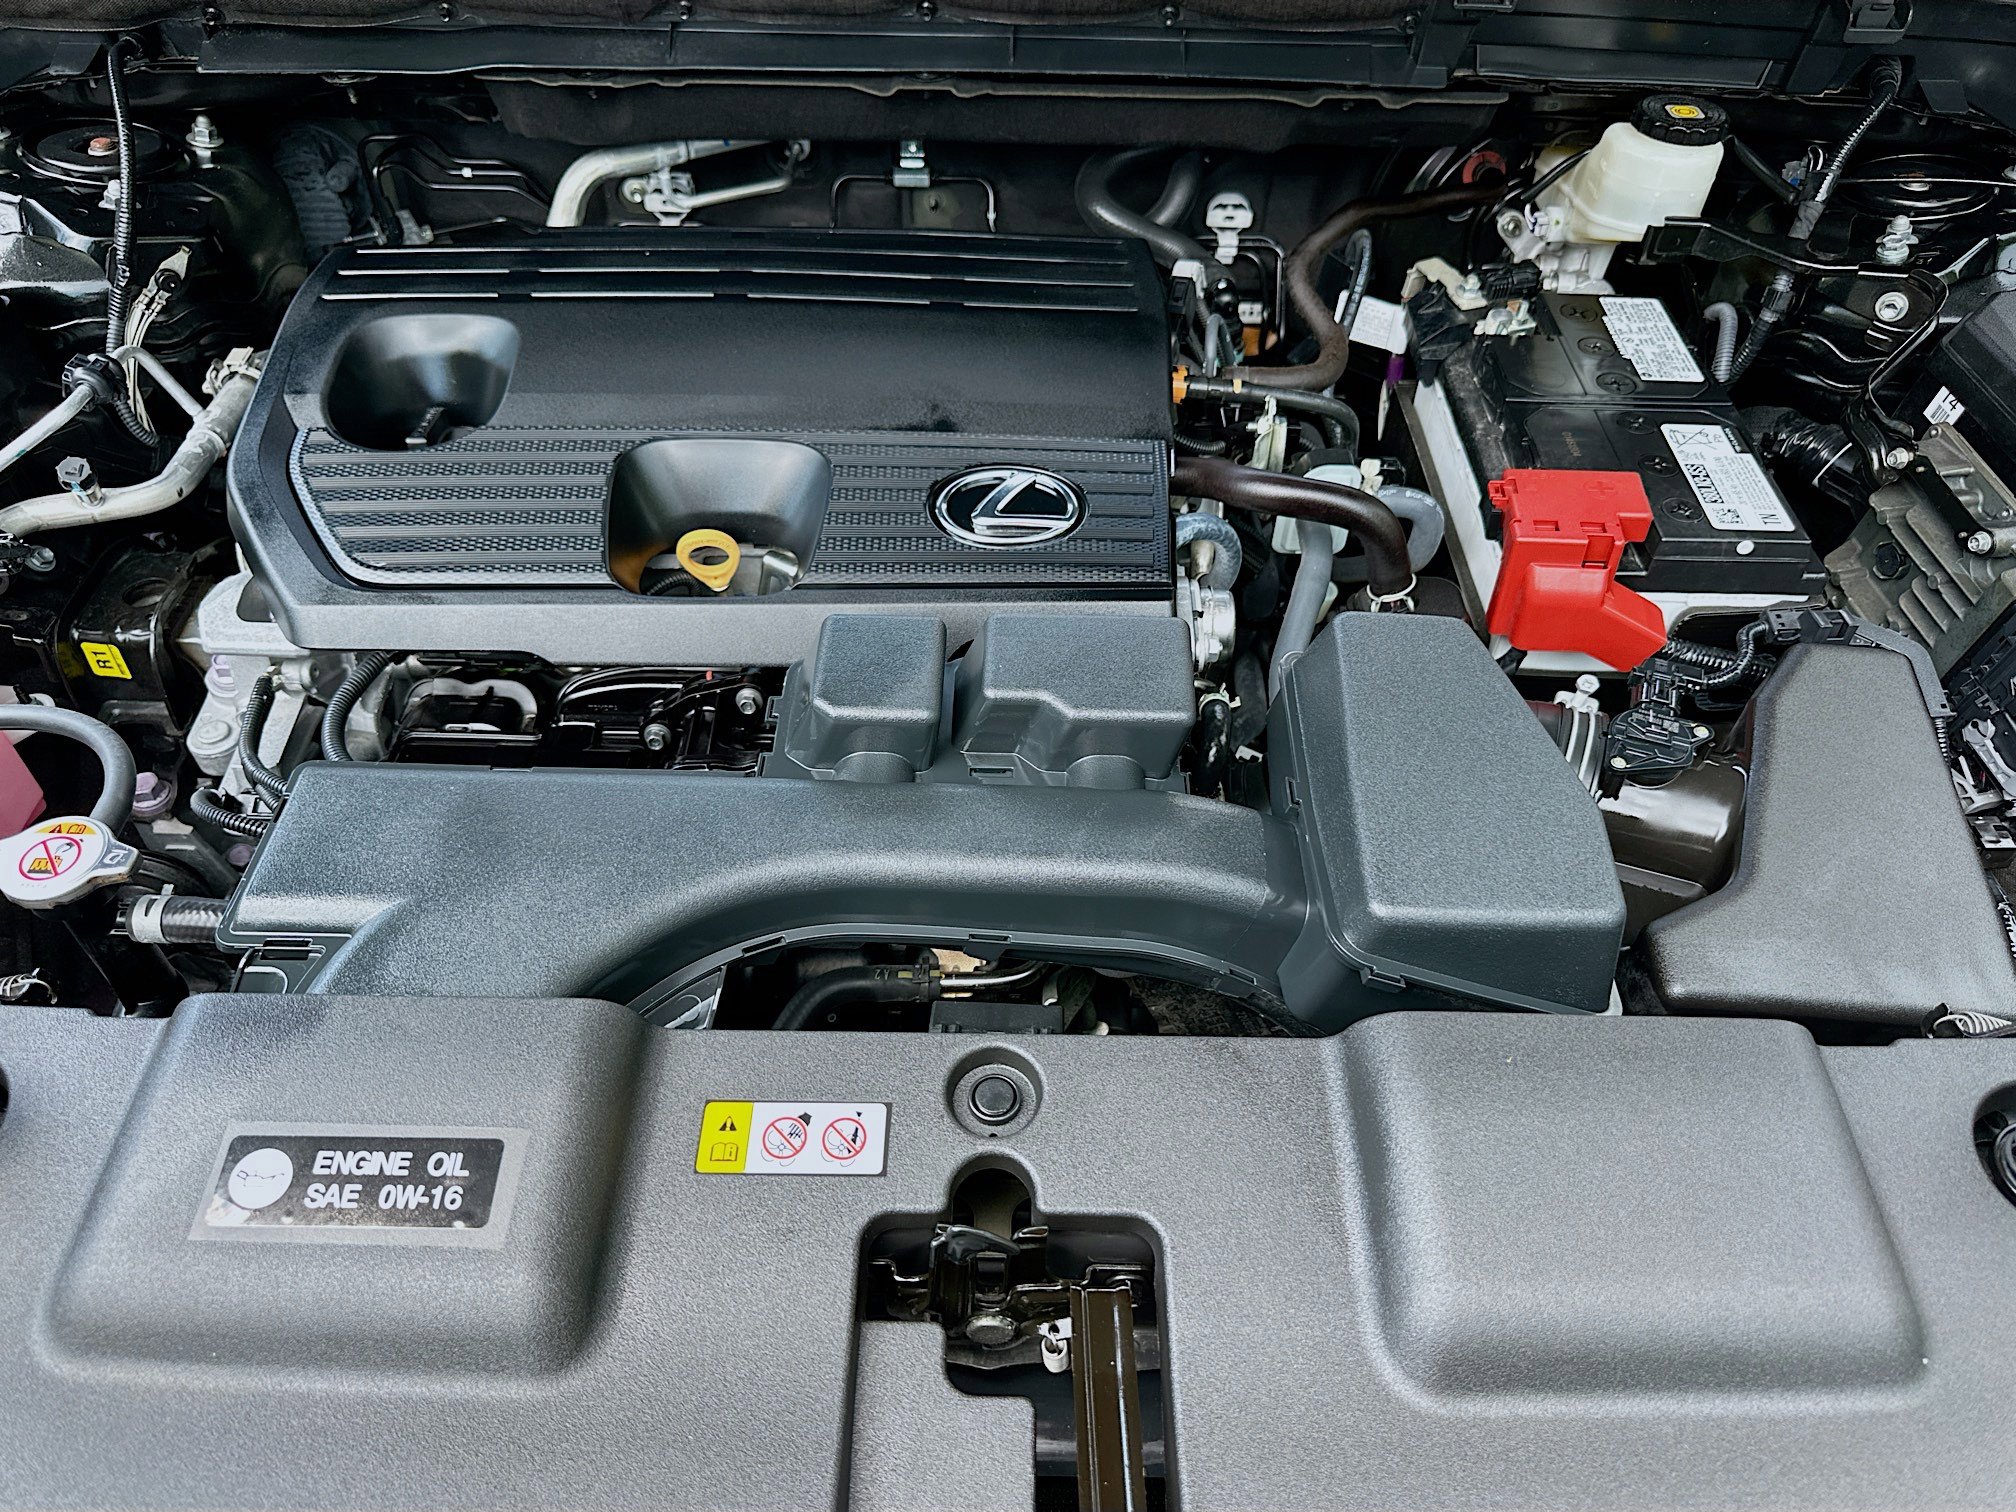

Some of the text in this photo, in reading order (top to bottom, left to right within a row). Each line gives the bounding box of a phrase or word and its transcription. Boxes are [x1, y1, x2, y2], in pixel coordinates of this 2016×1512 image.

[91, 651, 114, 669] R1
[312, 1150, 470, 1177] ENGINE OIL
[304, 1183, 464, 1211] SAE 0W-16
